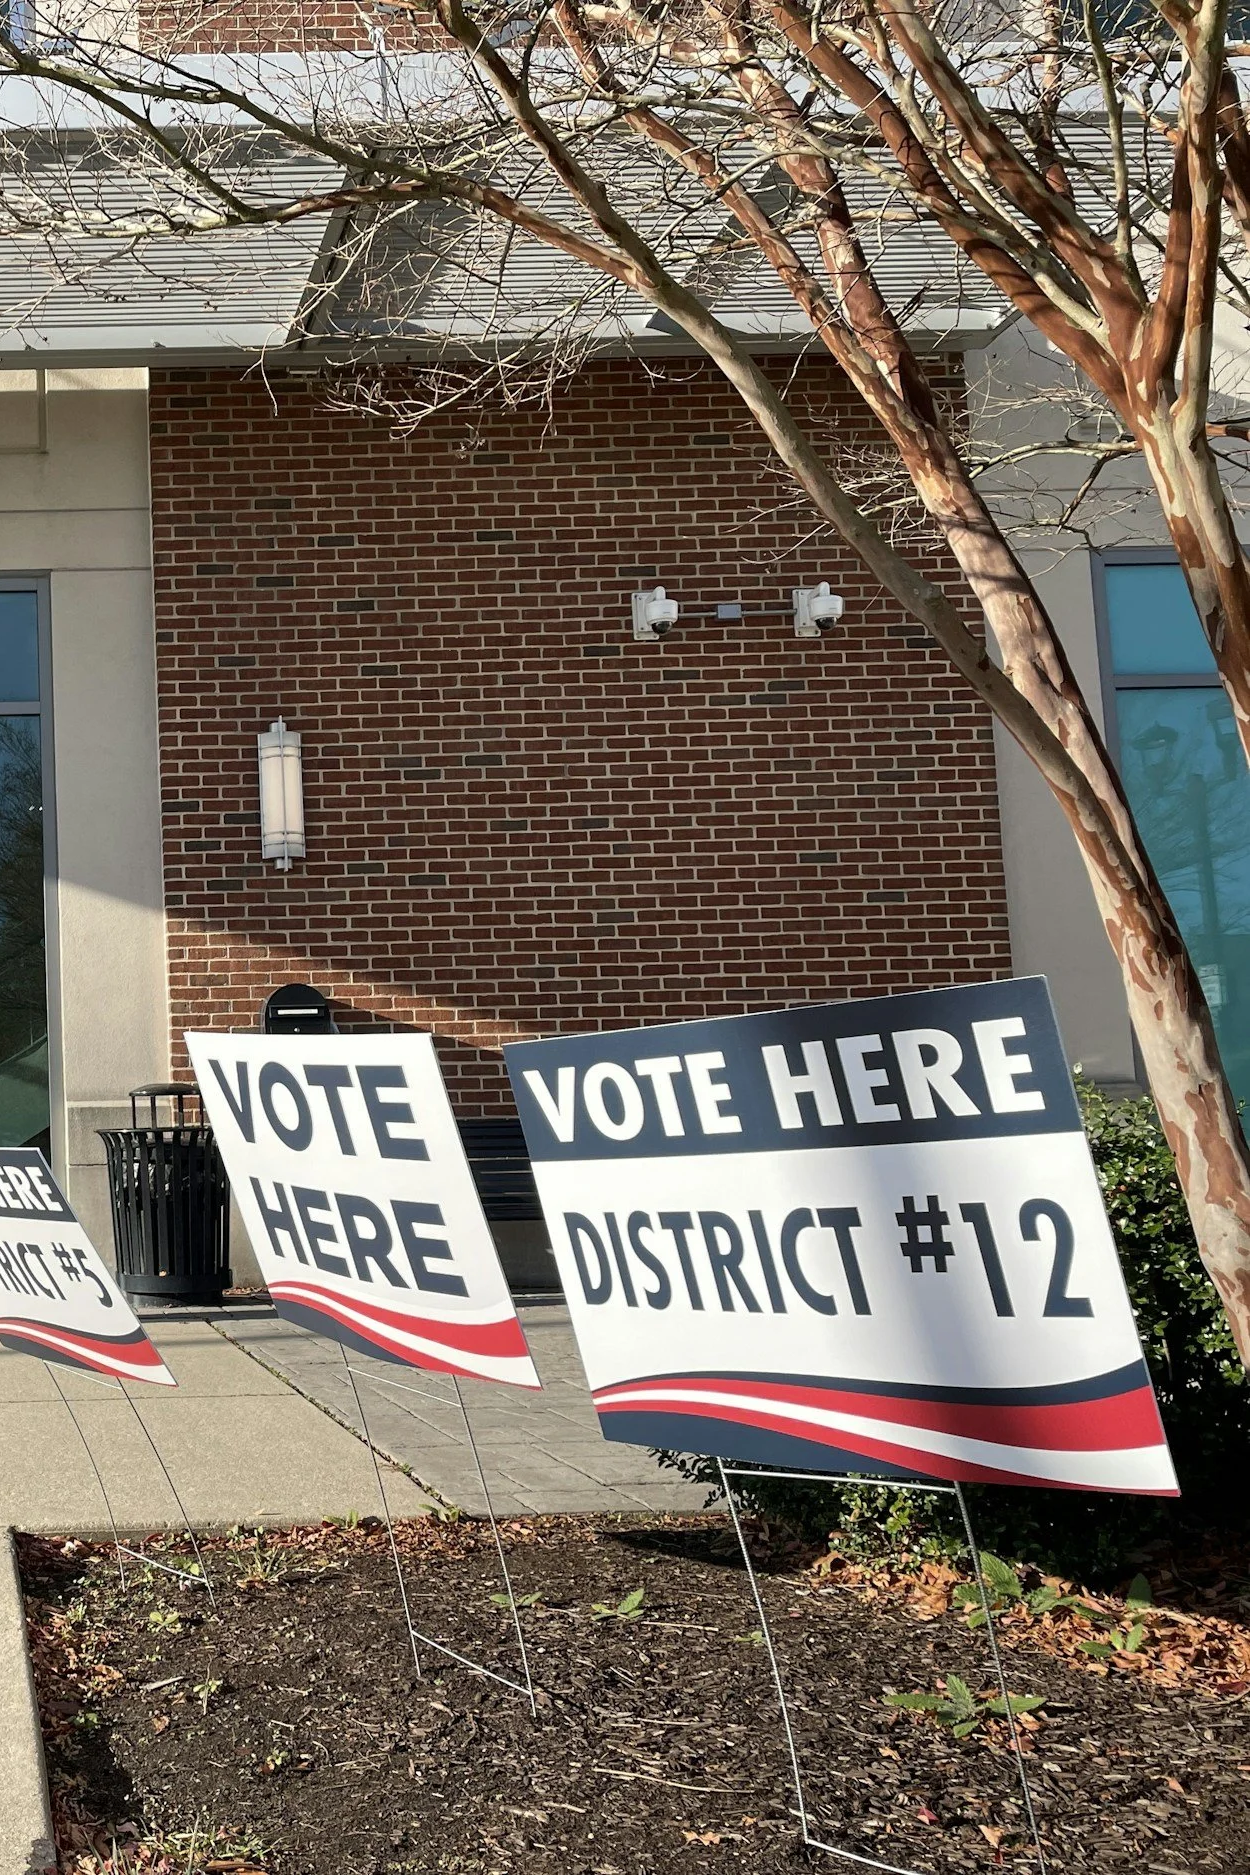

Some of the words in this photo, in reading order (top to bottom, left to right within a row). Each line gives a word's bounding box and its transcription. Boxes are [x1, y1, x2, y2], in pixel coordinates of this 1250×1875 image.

[207, 1059, 430, 1162] VOTE
[523, 1051, 742, 1144] VOTE
[761, 1016, 1046, 1131] HERE
[54, 1241, 113, 1308] #5
[249, 1177, 470, 1297] HERE
[564, 1206, 873, 1317] DISTRICT
[896, 1194, 1094, 1319] #12
